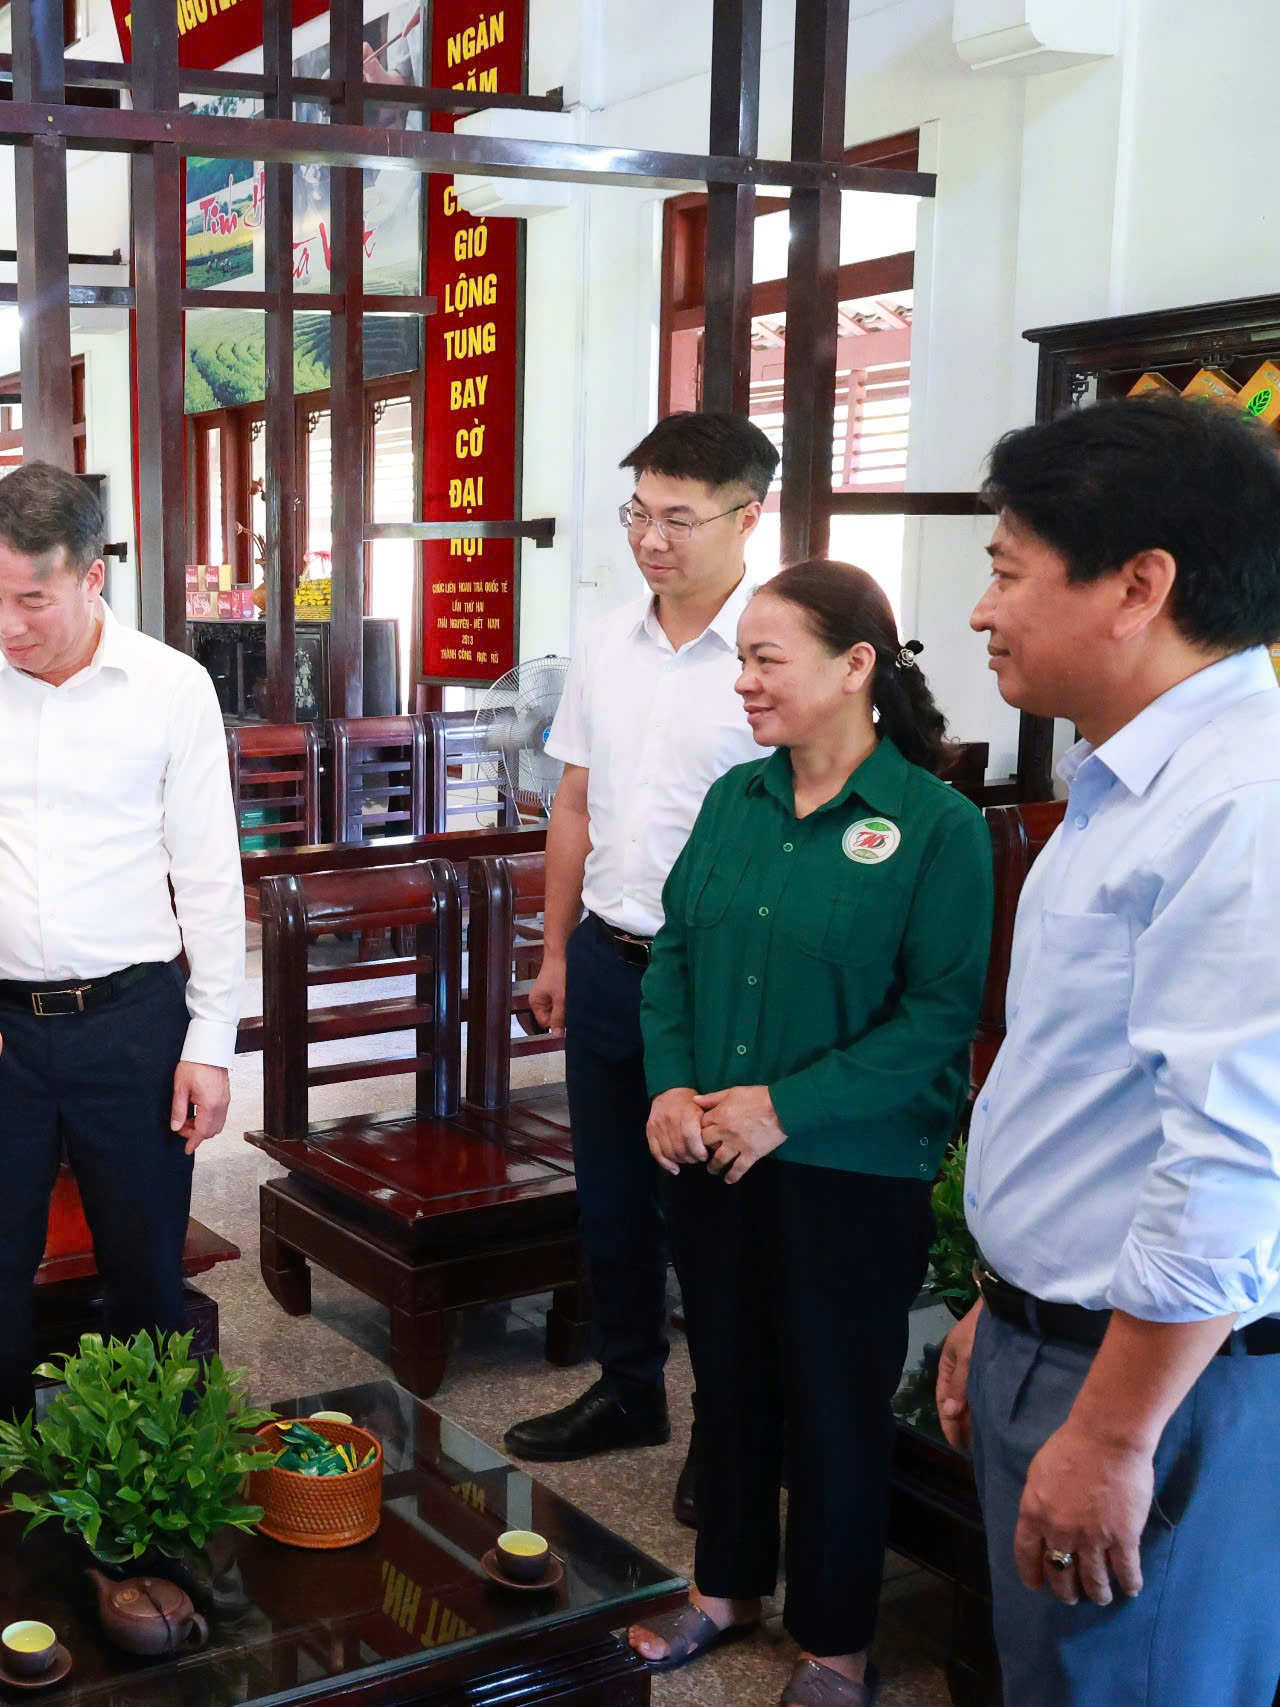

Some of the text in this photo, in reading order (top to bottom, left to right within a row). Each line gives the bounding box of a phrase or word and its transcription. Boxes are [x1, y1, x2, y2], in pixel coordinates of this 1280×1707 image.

[447, 11, 504, 68] NGÀN
[454, 217, 488, 262] GIÓ
[444, 273, 497, 318] LỘNG
[444, 322, 496, 361] TUNG
[450, 375, 488, 411] BAY
[456, 418, 486, 459] CỜ
[449, 476, 484, 514] ĐẠI
[459, 582, 472, 593] HOAN
[473, 580, 483, 593] TRÀ
[485, 578, 499, 593] QUỐC
[462, 634, 474, 646] 2013
